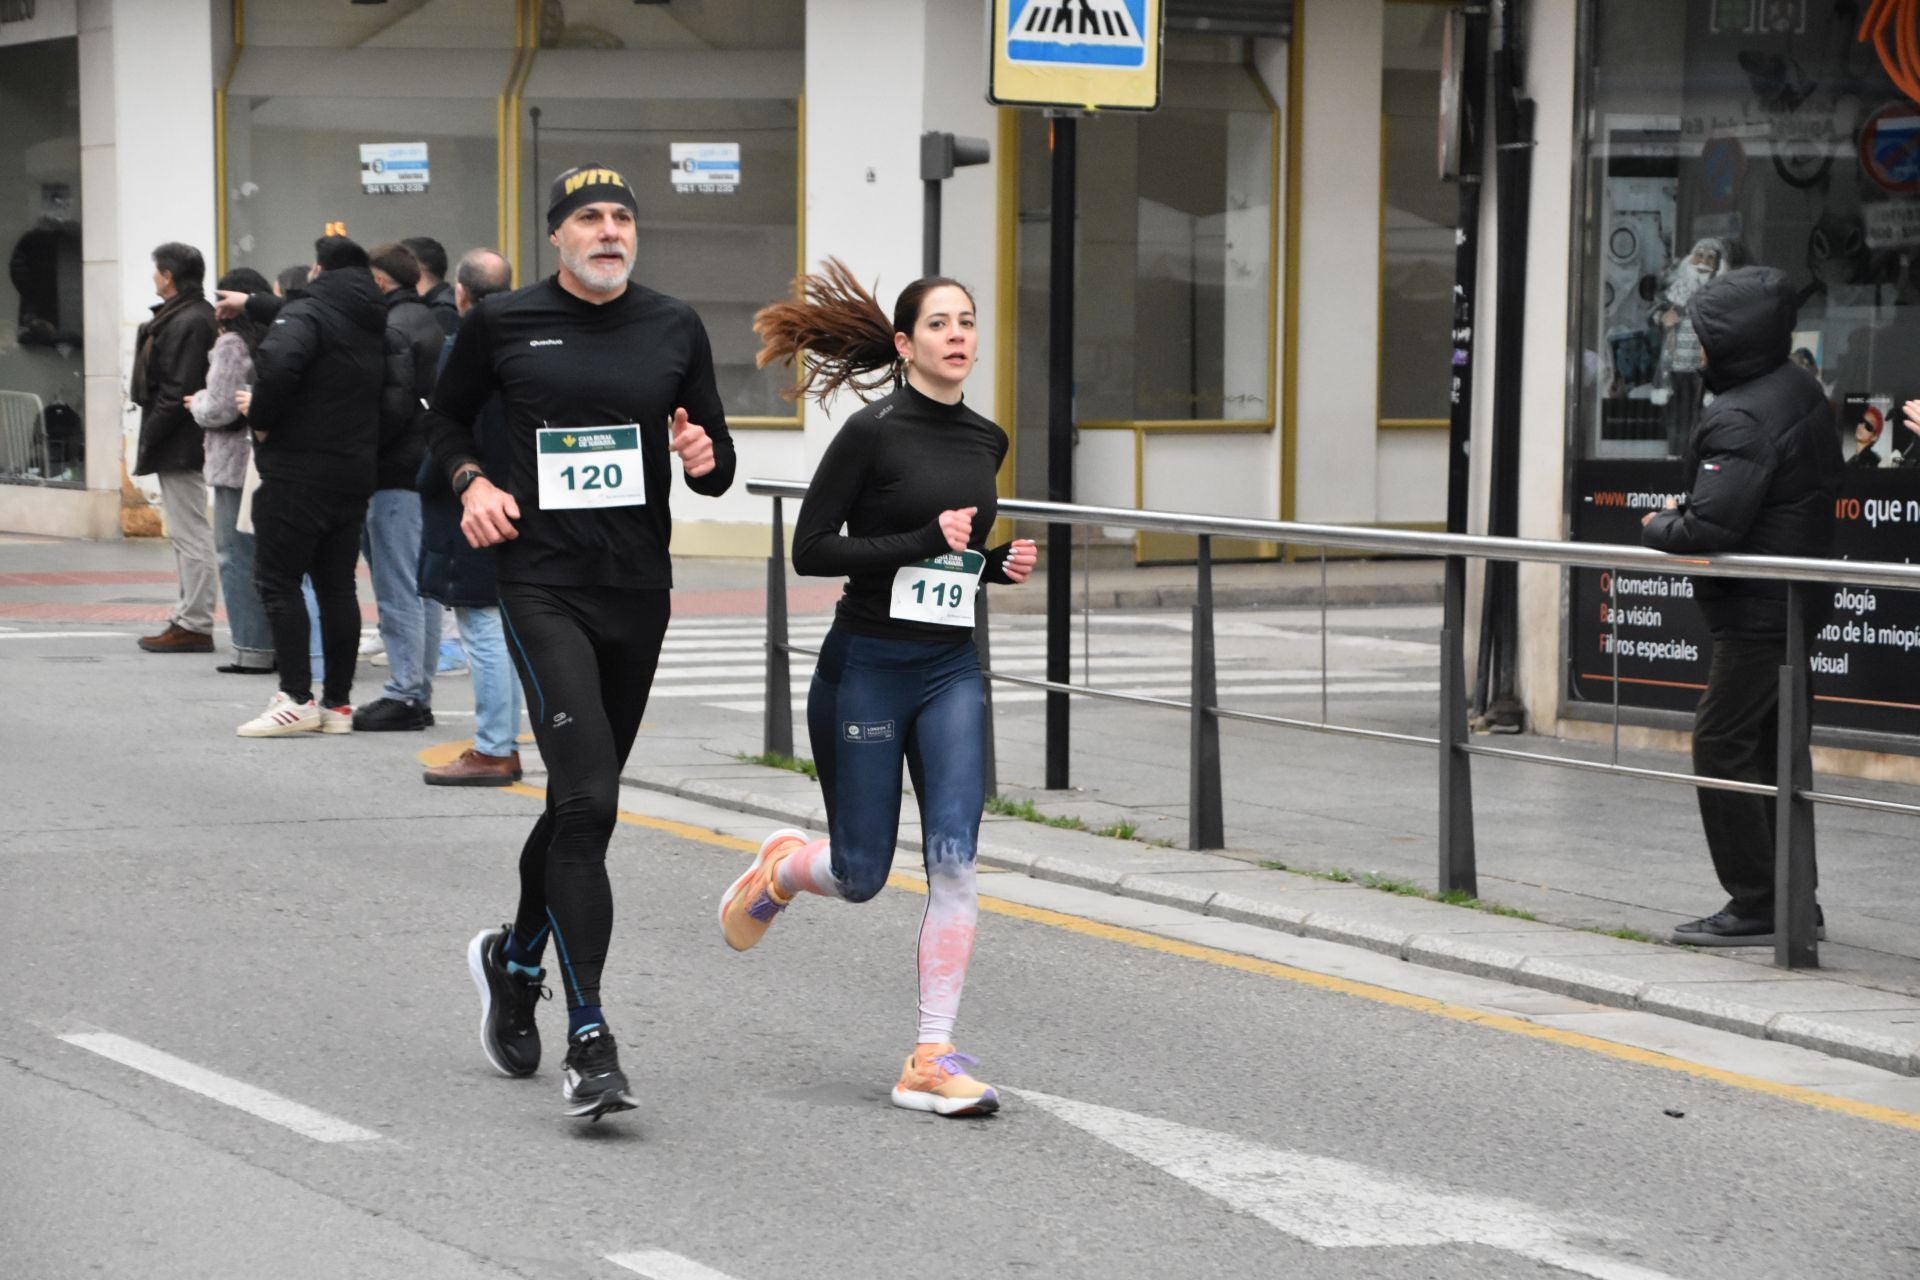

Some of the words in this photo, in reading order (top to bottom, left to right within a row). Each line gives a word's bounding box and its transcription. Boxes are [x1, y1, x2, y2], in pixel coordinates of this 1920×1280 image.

[560, 463, 623, 490] 120
[1864, 499, 1902, 528] que
[911, 579, 963, 608] 119
[1600, 602, 1625, 625] Baa
[1627, 605, 1662, 627] visión
[1843, 620, 1860, 643] de
[1863, 621, 1876, 644] la
[1600, 633, 1635, 656] Filros
[1637, 639, 1699, 662] especiales
[1810, 651, 1849, 674] visual
